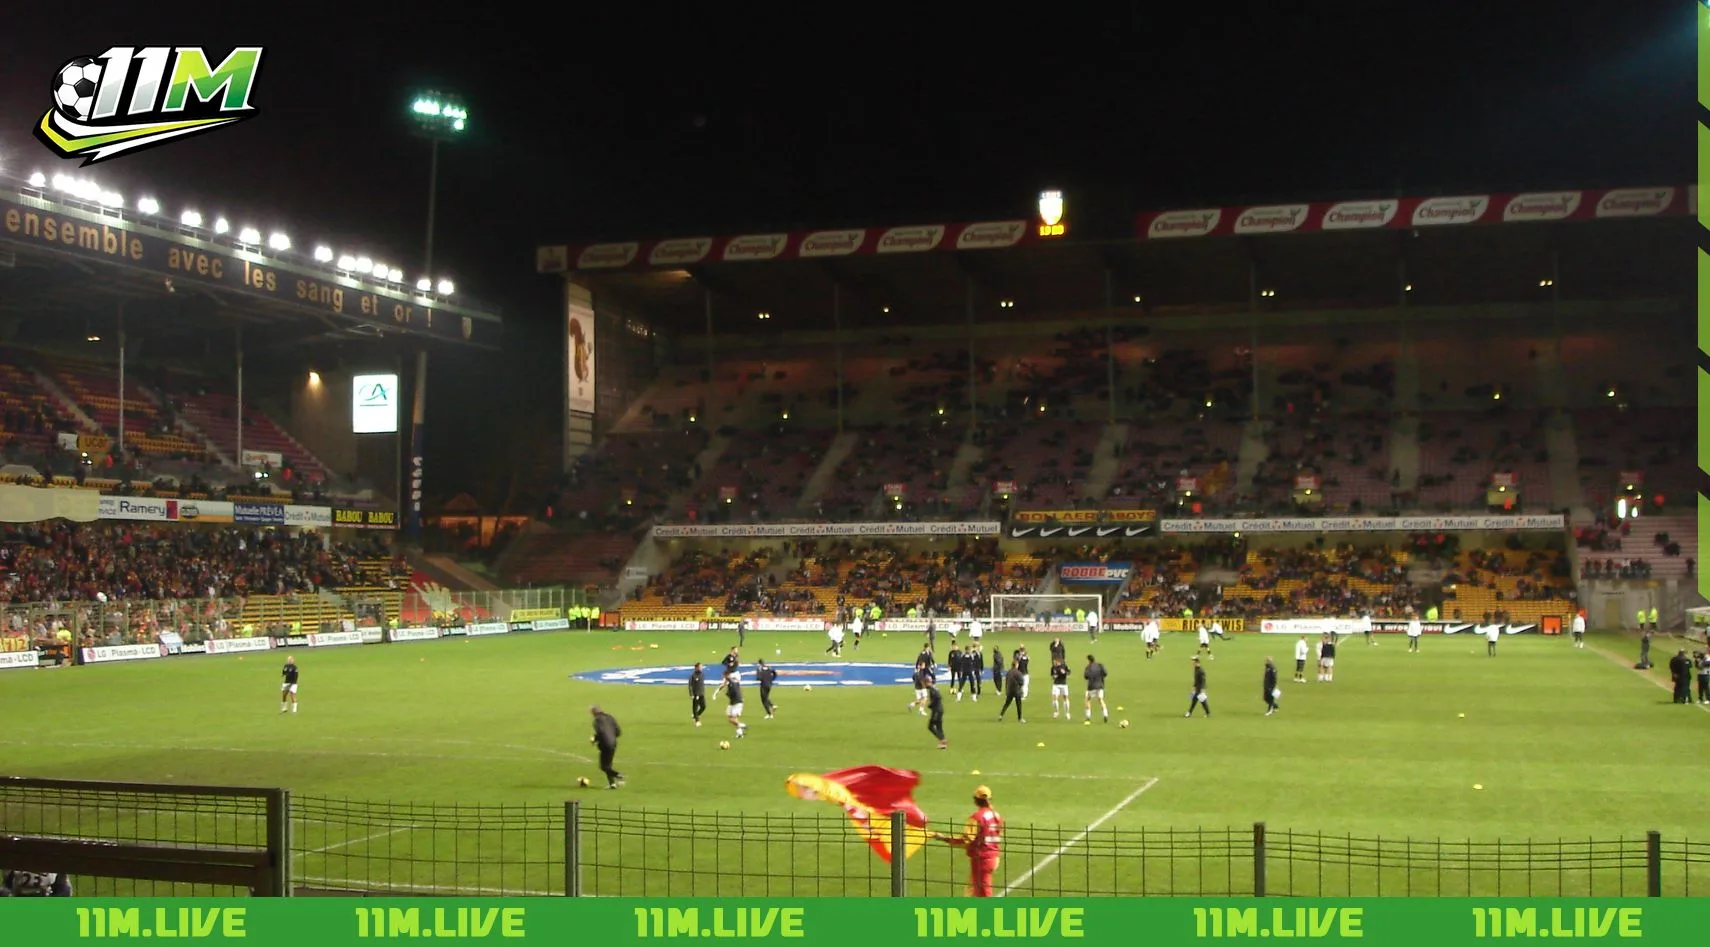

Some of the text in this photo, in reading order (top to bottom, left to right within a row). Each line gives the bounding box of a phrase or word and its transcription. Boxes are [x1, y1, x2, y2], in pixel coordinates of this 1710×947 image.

[5, 208, 143, 260] ensemble
[168, 246, 223, 279] avec
[244, 260, 276, 291] les
[296, 279, 344, 313] sang
[361, 294, 379, 316] et
[394, 303, 412, 323] or
[120, 500, 165, 517] Ramery
[336, 509, 394, 524] BABOU BABOU
[17, 653, 33, 663] LCD
[111, 647, 137, 656] Plasma
[142, 646, 156, 655] LCD
